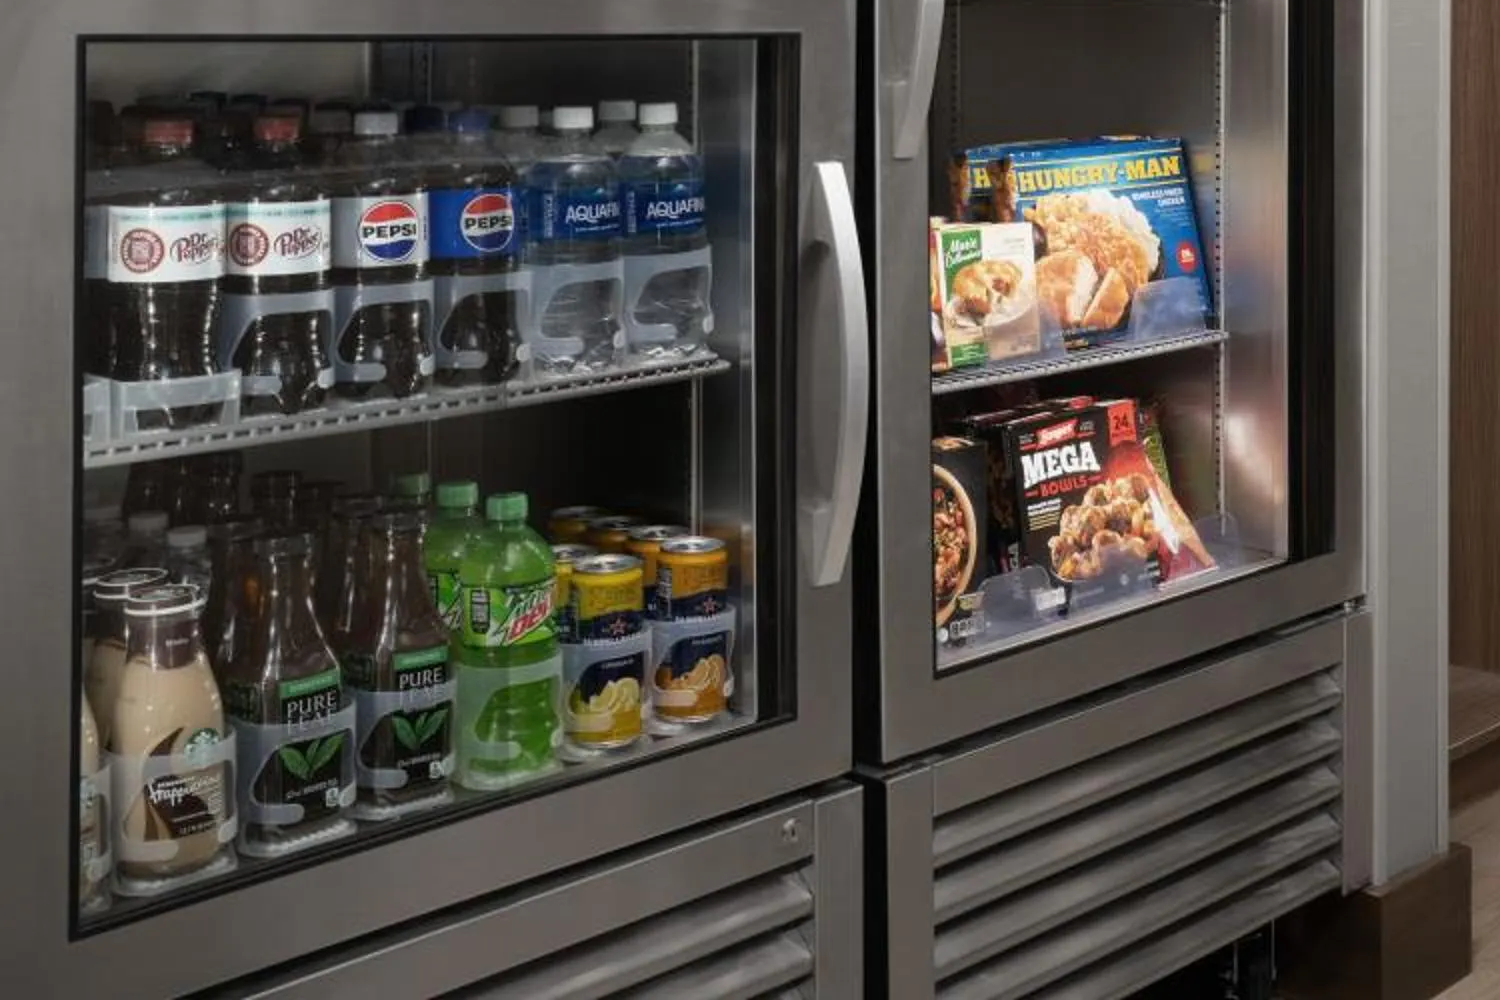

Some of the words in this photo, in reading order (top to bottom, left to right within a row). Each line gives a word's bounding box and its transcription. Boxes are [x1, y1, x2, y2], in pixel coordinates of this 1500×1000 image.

[363, 223, 417, 240] PEPSI
[1020, 440, 1102, 490] MEGA
[1041, 475, 1088, 497] BOWLS
[400, 667, 443, 690] PURE
[287, 690, 337, 717] PURE
